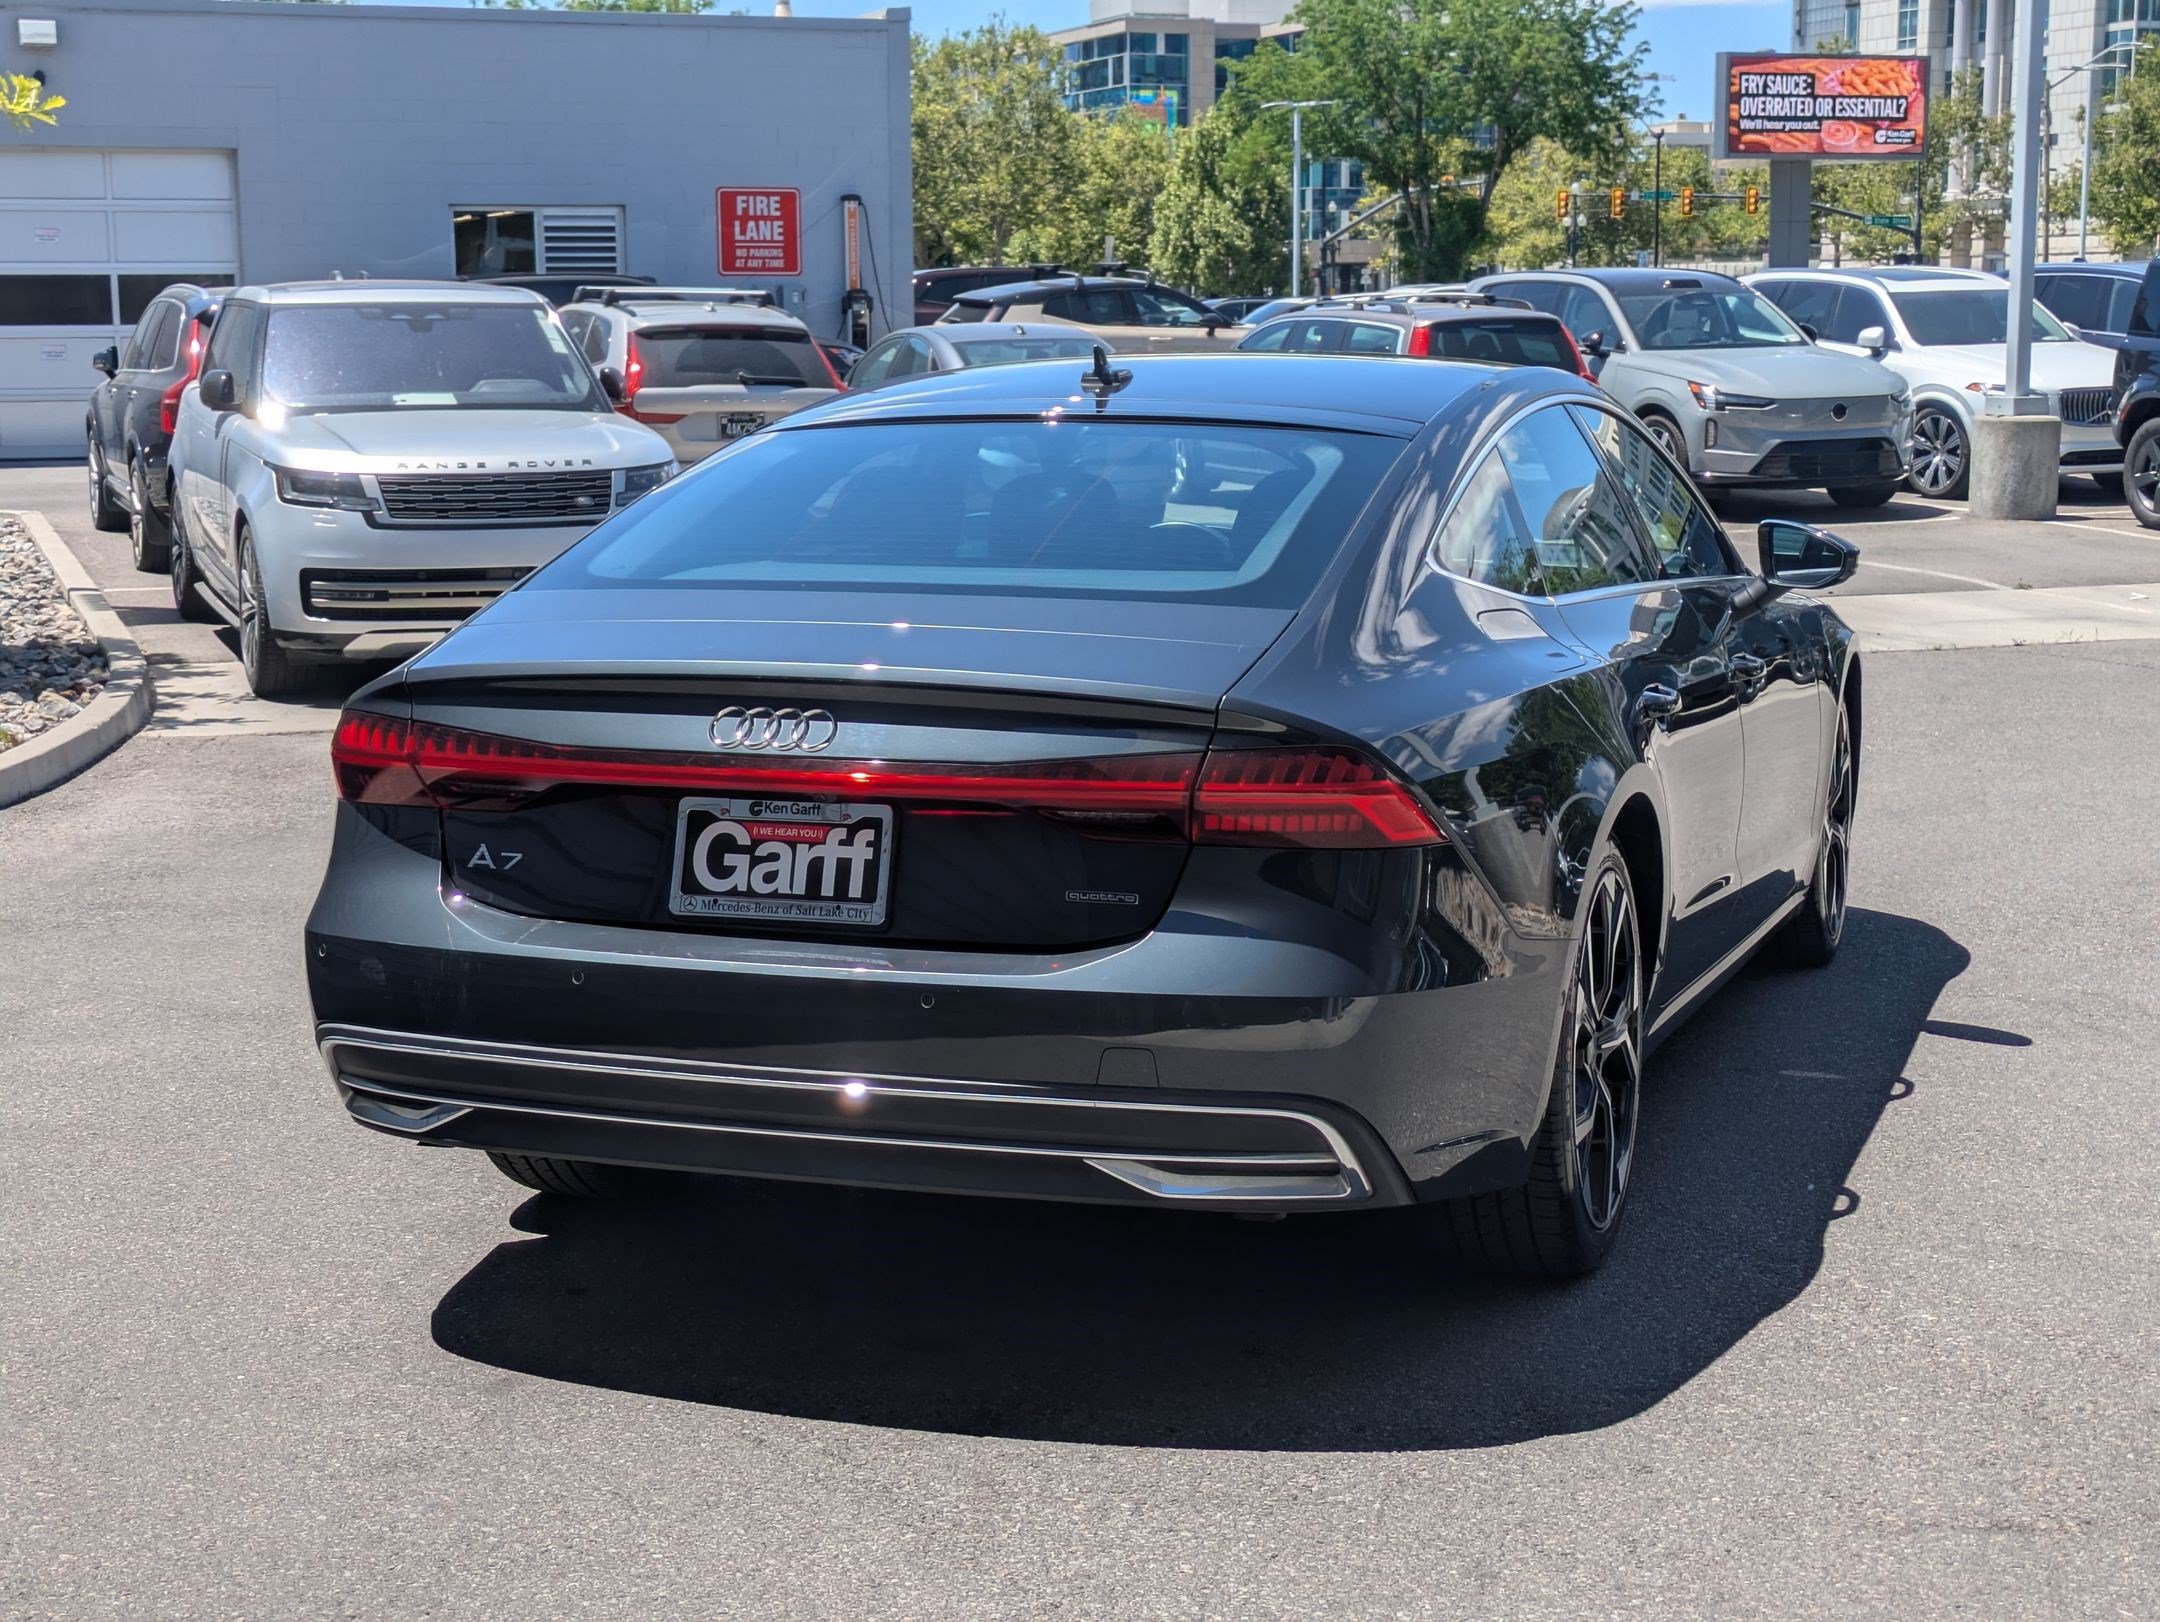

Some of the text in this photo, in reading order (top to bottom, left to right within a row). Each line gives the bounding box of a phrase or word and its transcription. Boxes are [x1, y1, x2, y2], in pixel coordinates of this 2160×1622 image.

[1741, 75, 1812, 95] FRY SAUCE:
[1740, 97, 1907, 118] OVERRATED OR ESSENTIAL?
[1763, 120, 1784, 130] hear
[1784, 121, 1802, 131] you
[1802, 121, 1820, 130] out.
[736, 195, 781, 216] FIRE
[734, 220, 784, 241] LANE
[735, 248, 784, 257] NO PARKING
[735, 259, 784, 268] AT ANY TIME
[397, 459, 593, 470] RANGE ROVER
[764, 801, 822, 816] Ken Garff
[760, 828, 818, 838] WE HEAR YOU
[467, 843, 523, 870] A7
[692, 820, 875, 899] Garff
[1069, 892, 1135, 902] quattro
[700, 899, 870, 920] Mercedes-Benz of Salt Lake City
